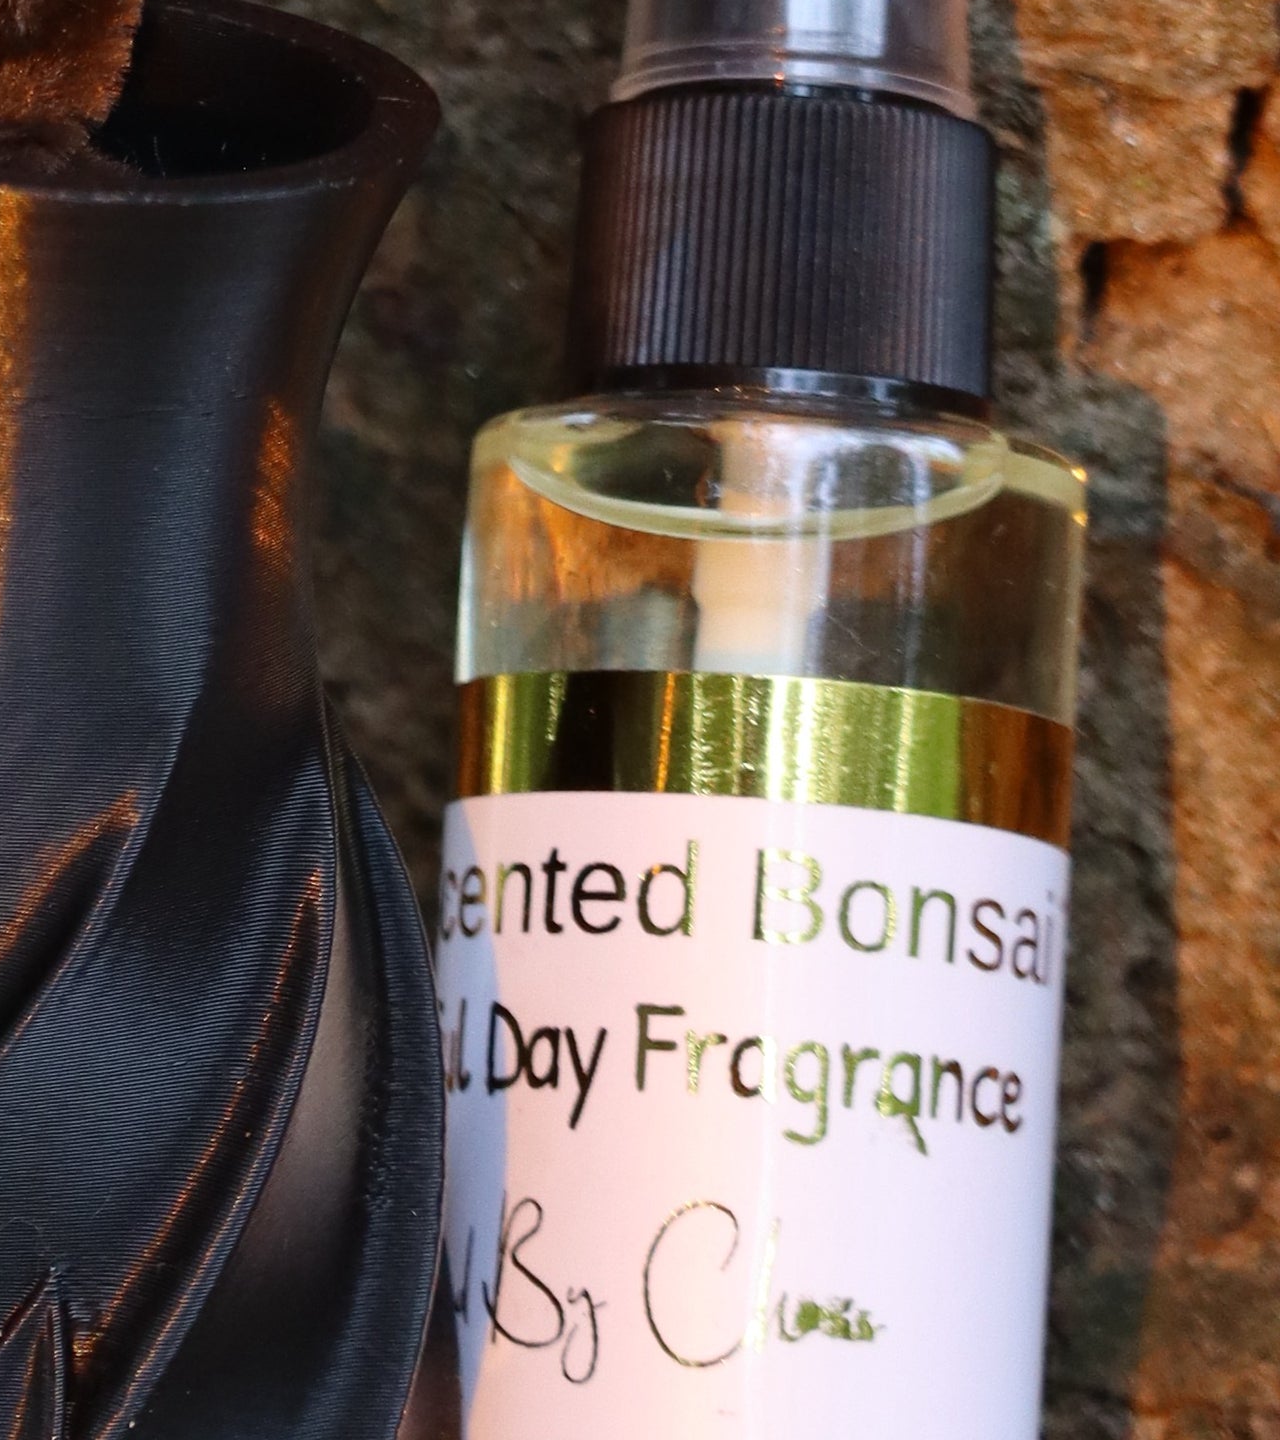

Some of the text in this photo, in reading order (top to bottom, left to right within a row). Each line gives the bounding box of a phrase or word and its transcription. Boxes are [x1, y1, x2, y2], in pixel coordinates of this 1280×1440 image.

[752, 847, 1057, 988] Bonsai
[486, 1001, 608, 1131] Day
[634, 1003, 1026, 1155] Fragrance
